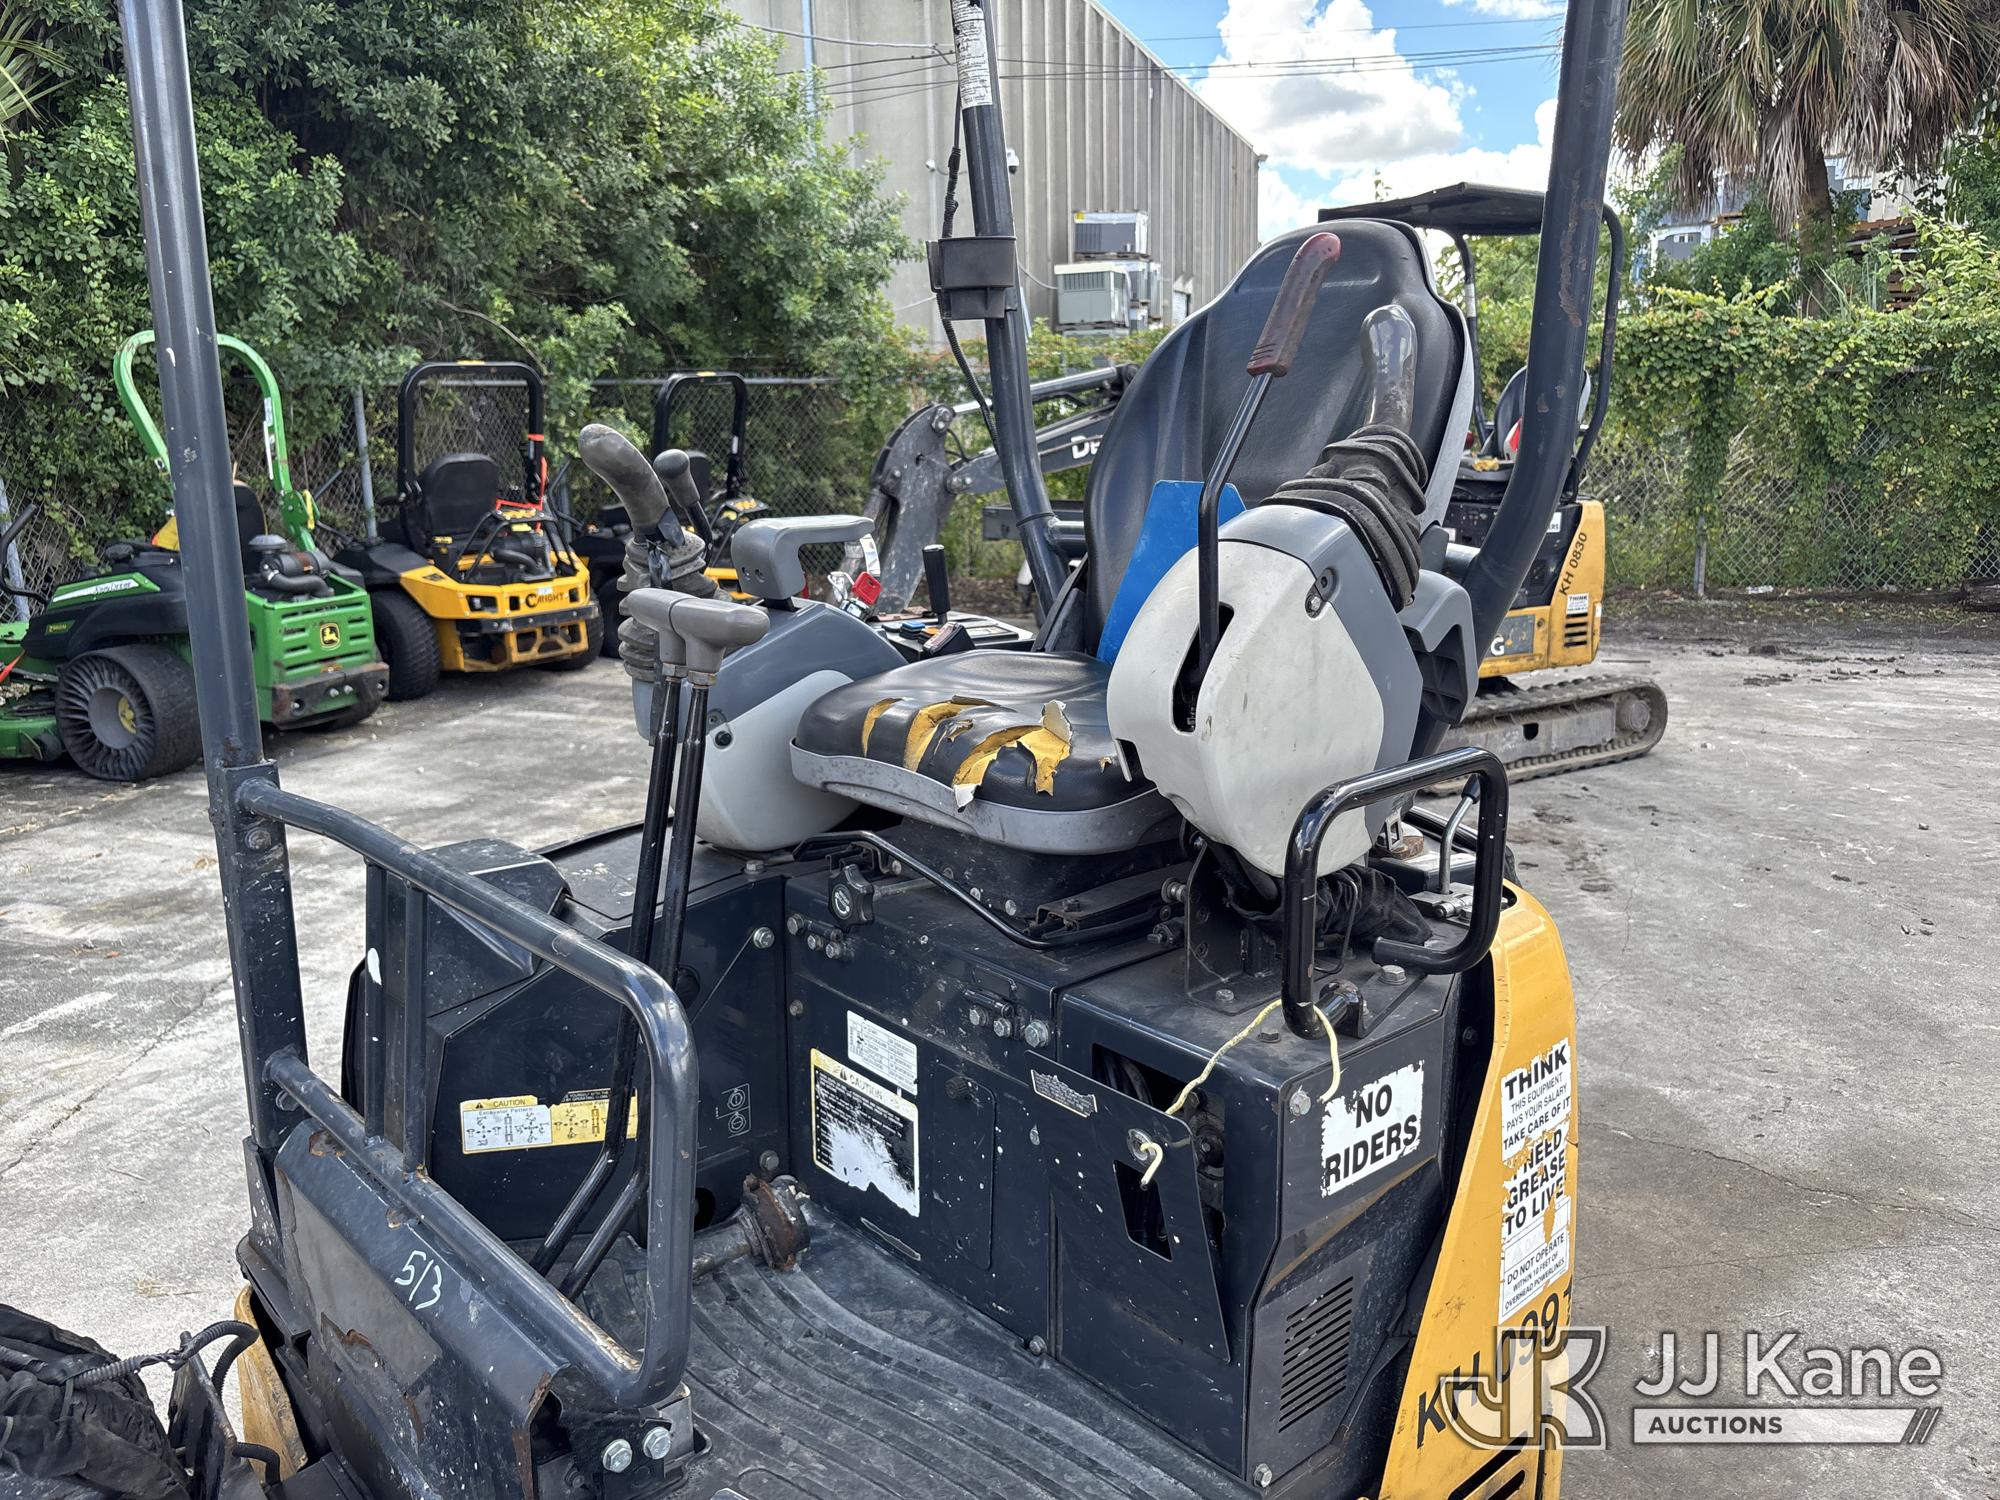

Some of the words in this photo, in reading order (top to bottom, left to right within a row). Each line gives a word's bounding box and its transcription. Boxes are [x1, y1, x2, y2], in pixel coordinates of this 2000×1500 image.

[1559, 571, 1574, 596] KH
[1569, 532, 1588, 569] 0830
[849, 1074, 882, 1101] CAUTION
[1505, 1044, 1567, 1101] THINK
[1511, 1097, 1526, 1113] THIS
[1527, 1072, 1563, 1103] EQUIPMENT
[493, 1099, 526, 1108] CAUTION
[1356, 1084, 1393, 1129] NO
[1503, 1127, 1526, 1150] TAKE
[1527, 1112, 1549, 1133] CARE
[1551, 1102, 1561, 1118] OF
[1562, 1096, 1571, 1110] IT
[1506, 1113, 1523, 1132] PAYS
[1524, 1100, 1543, 1119] YOUR
[1543, 1083, 1567, 1107] SALARY
[1324, 1114, 1418, 1188] RIDERS
[1523, 1128, 1562, 1174] NEED
[1507, 1149, 1566, 1209] GREASE
[1505, 1206, 1527, 1236] TO
[1532, 1175, 1564, 1218] LIVE
[1504, 1282, 1534, 1310] OVERHEAD
[1534, 1257, 1565, 1287] POWERLINES
[1507, 1270, 1519, 1285] DO
[1519, 1257, 1535, 1276] NOT
[1535, 1233, 1564, 1263] OPERATE
[1513, 1273, 1532, 1292] WITHIN
[1533, 1267, 1539, 1276] 10
[1539, 1257, 1551, 1272] FEET
[1551, 1251, 1559, 1263] OF
